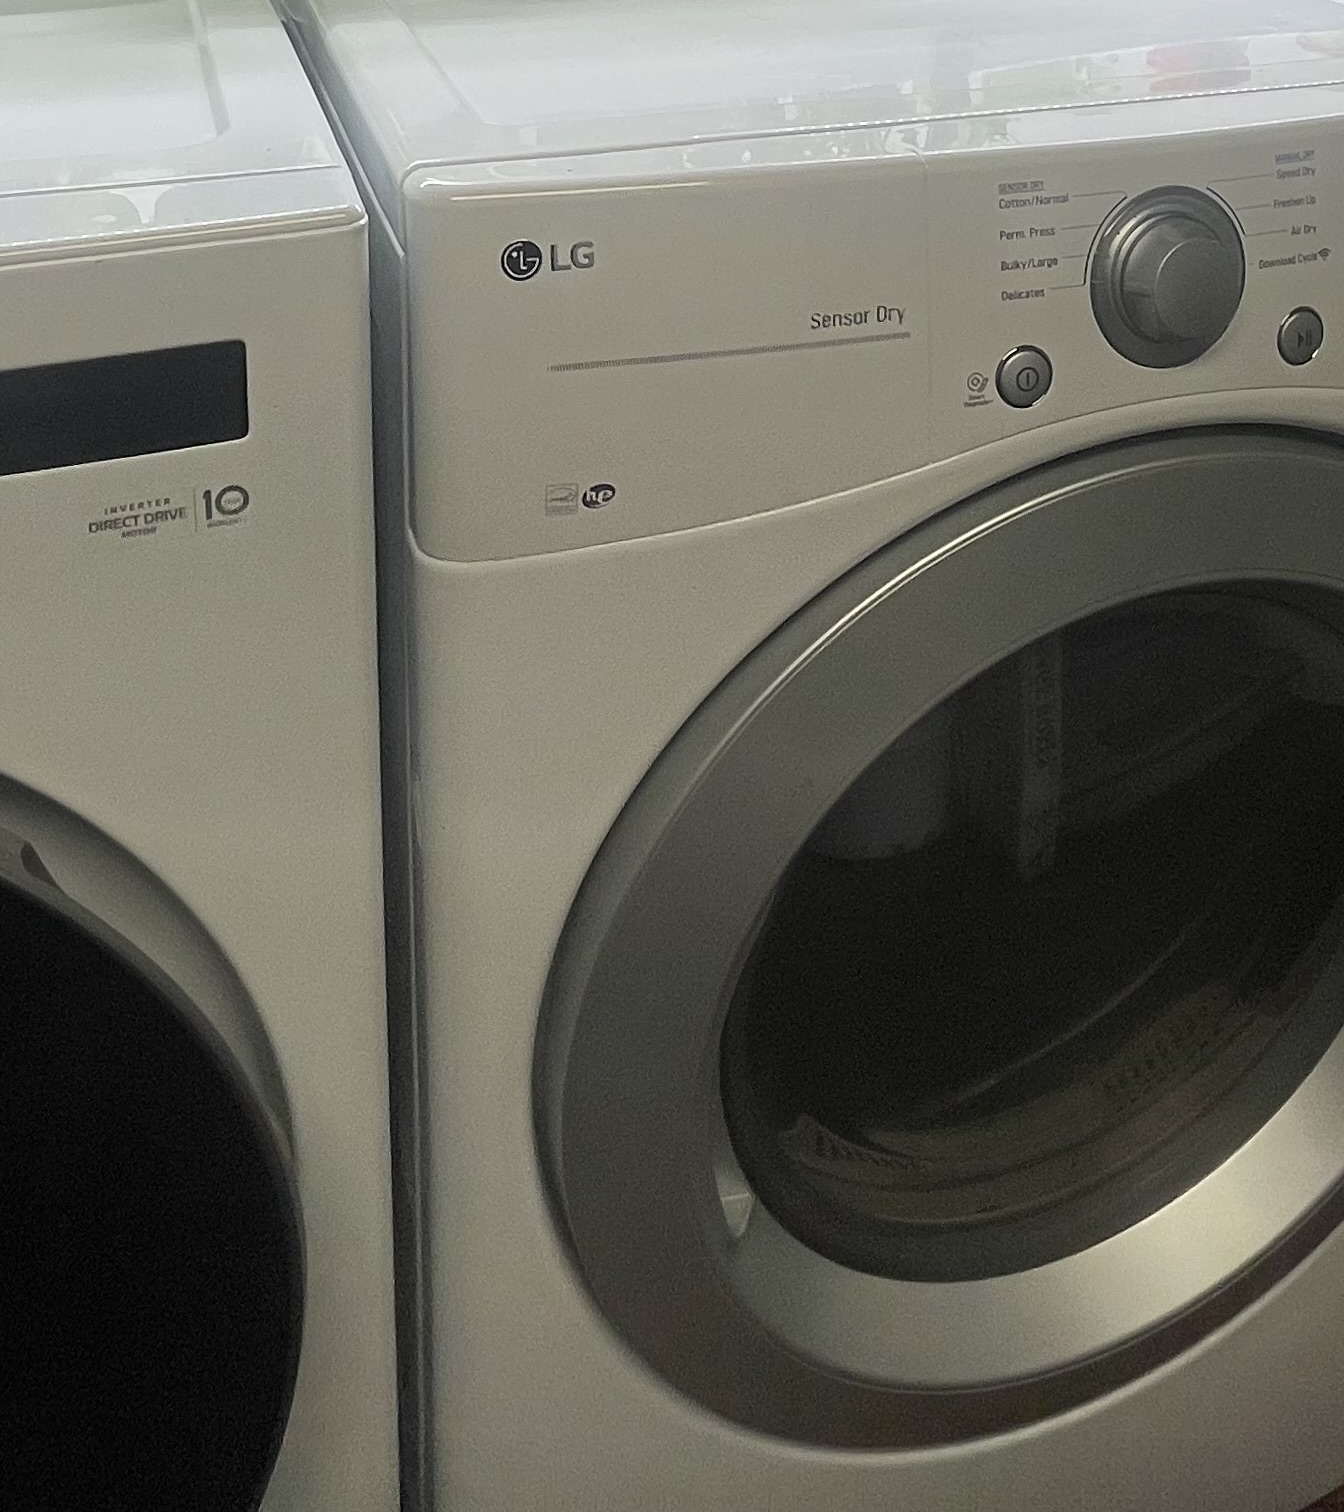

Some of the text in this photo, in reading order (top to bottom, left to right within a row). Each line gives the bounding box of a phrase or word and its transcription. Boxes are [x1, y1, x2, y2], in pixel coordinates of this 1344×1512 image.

[1302, 166, 1316, 177] Dry
[998, 193, 1069, 209] Cotton/Normal
[999, 227, 1056, 240] Perm. Press
[550, 241, 595, 271] LG
[1000, 257, 1058, 271] Bulky/Large
[1001, 289, 1045, 301] Delicates
[810, 304, 907, 330] Sensor Dry
[103, 497, 172, 516] INVERTER
[202, 484, 250, 521] 10
[88, 506, 188, 534] DIRECT DRIVE
